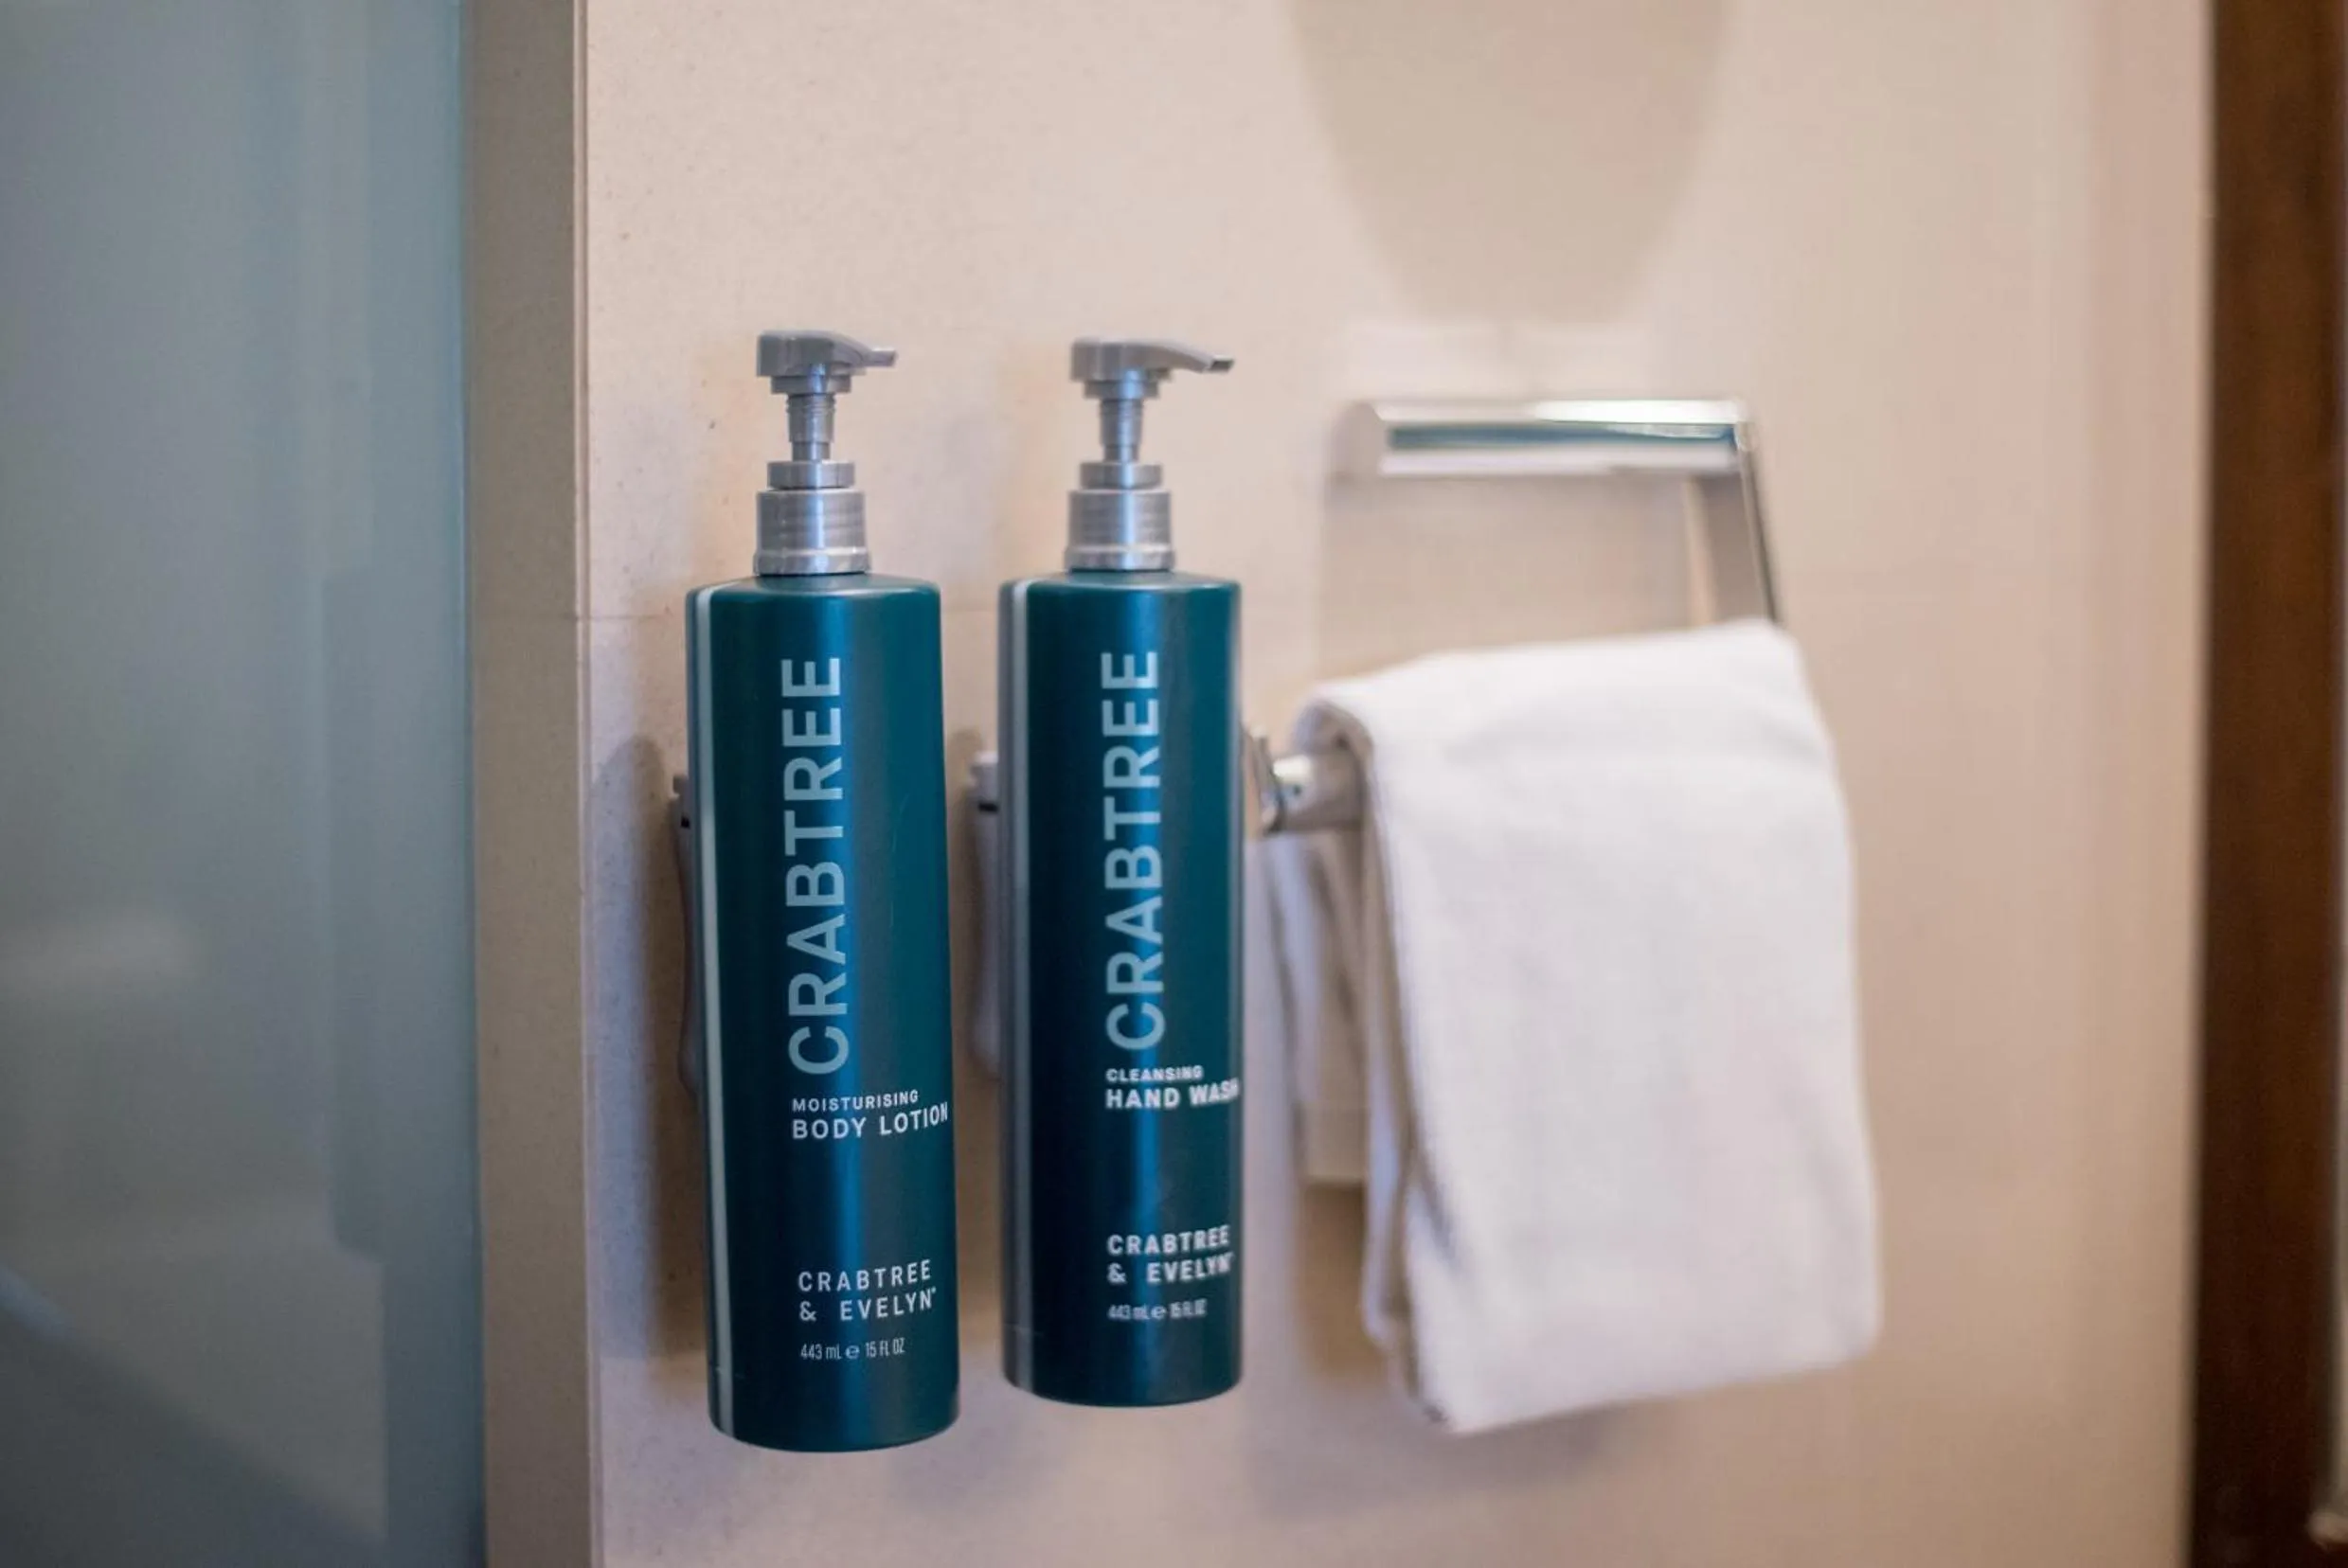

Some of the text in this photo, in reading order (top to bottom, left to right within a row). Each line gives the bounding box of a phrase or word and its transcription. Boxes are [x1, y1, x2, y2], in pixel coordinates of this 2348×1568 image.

[781, 657, 850, 1076] CRABTREE
[1101, 651, 1165, 1051] CRABTREE
[1105, 1065, 1204, 1082] CLEANSING
[792, 1089, 919, 1112] MOISTURISING
[1105, 1078, 1239, 1109] HAND WASH
[792, 1101, 948, 1139] BODY LOTION
[1106, 1224, 1230, 1256] CRABTREE
[798, 1259, 931, 1292] CRABTREE
[1107, 1262, 1126, 1285] &
[798, 1301, 816, 1322] &
[800, 1344, 822, 1360] 443
[826, 1344, 842, 1360] mL
[865, 1341, 876, 1358] 15
